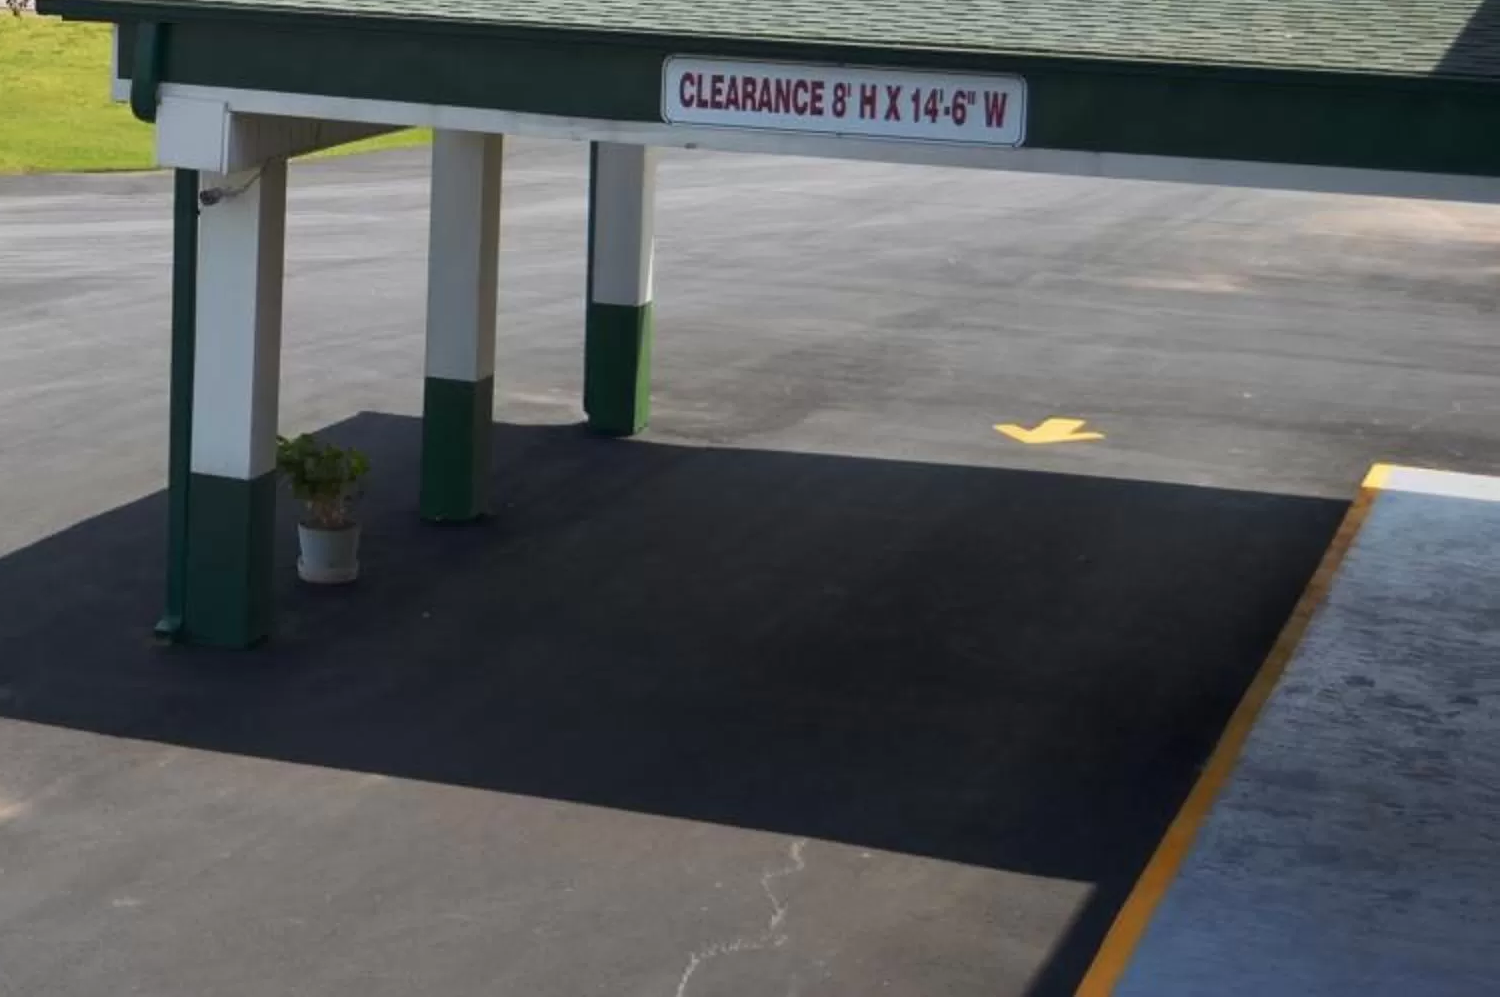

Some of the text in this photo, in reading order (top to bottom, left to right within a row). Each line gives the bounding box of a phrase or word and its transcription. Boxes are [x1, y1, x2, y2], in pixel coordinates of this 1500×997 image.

[679, 72, 824, 116] CLEARANCE
[831, 82, 852, 118] 8'
[859, 83, 877, 119] H
[884, 85, 902, 121] X
[984, 91, 1007, 128] W
